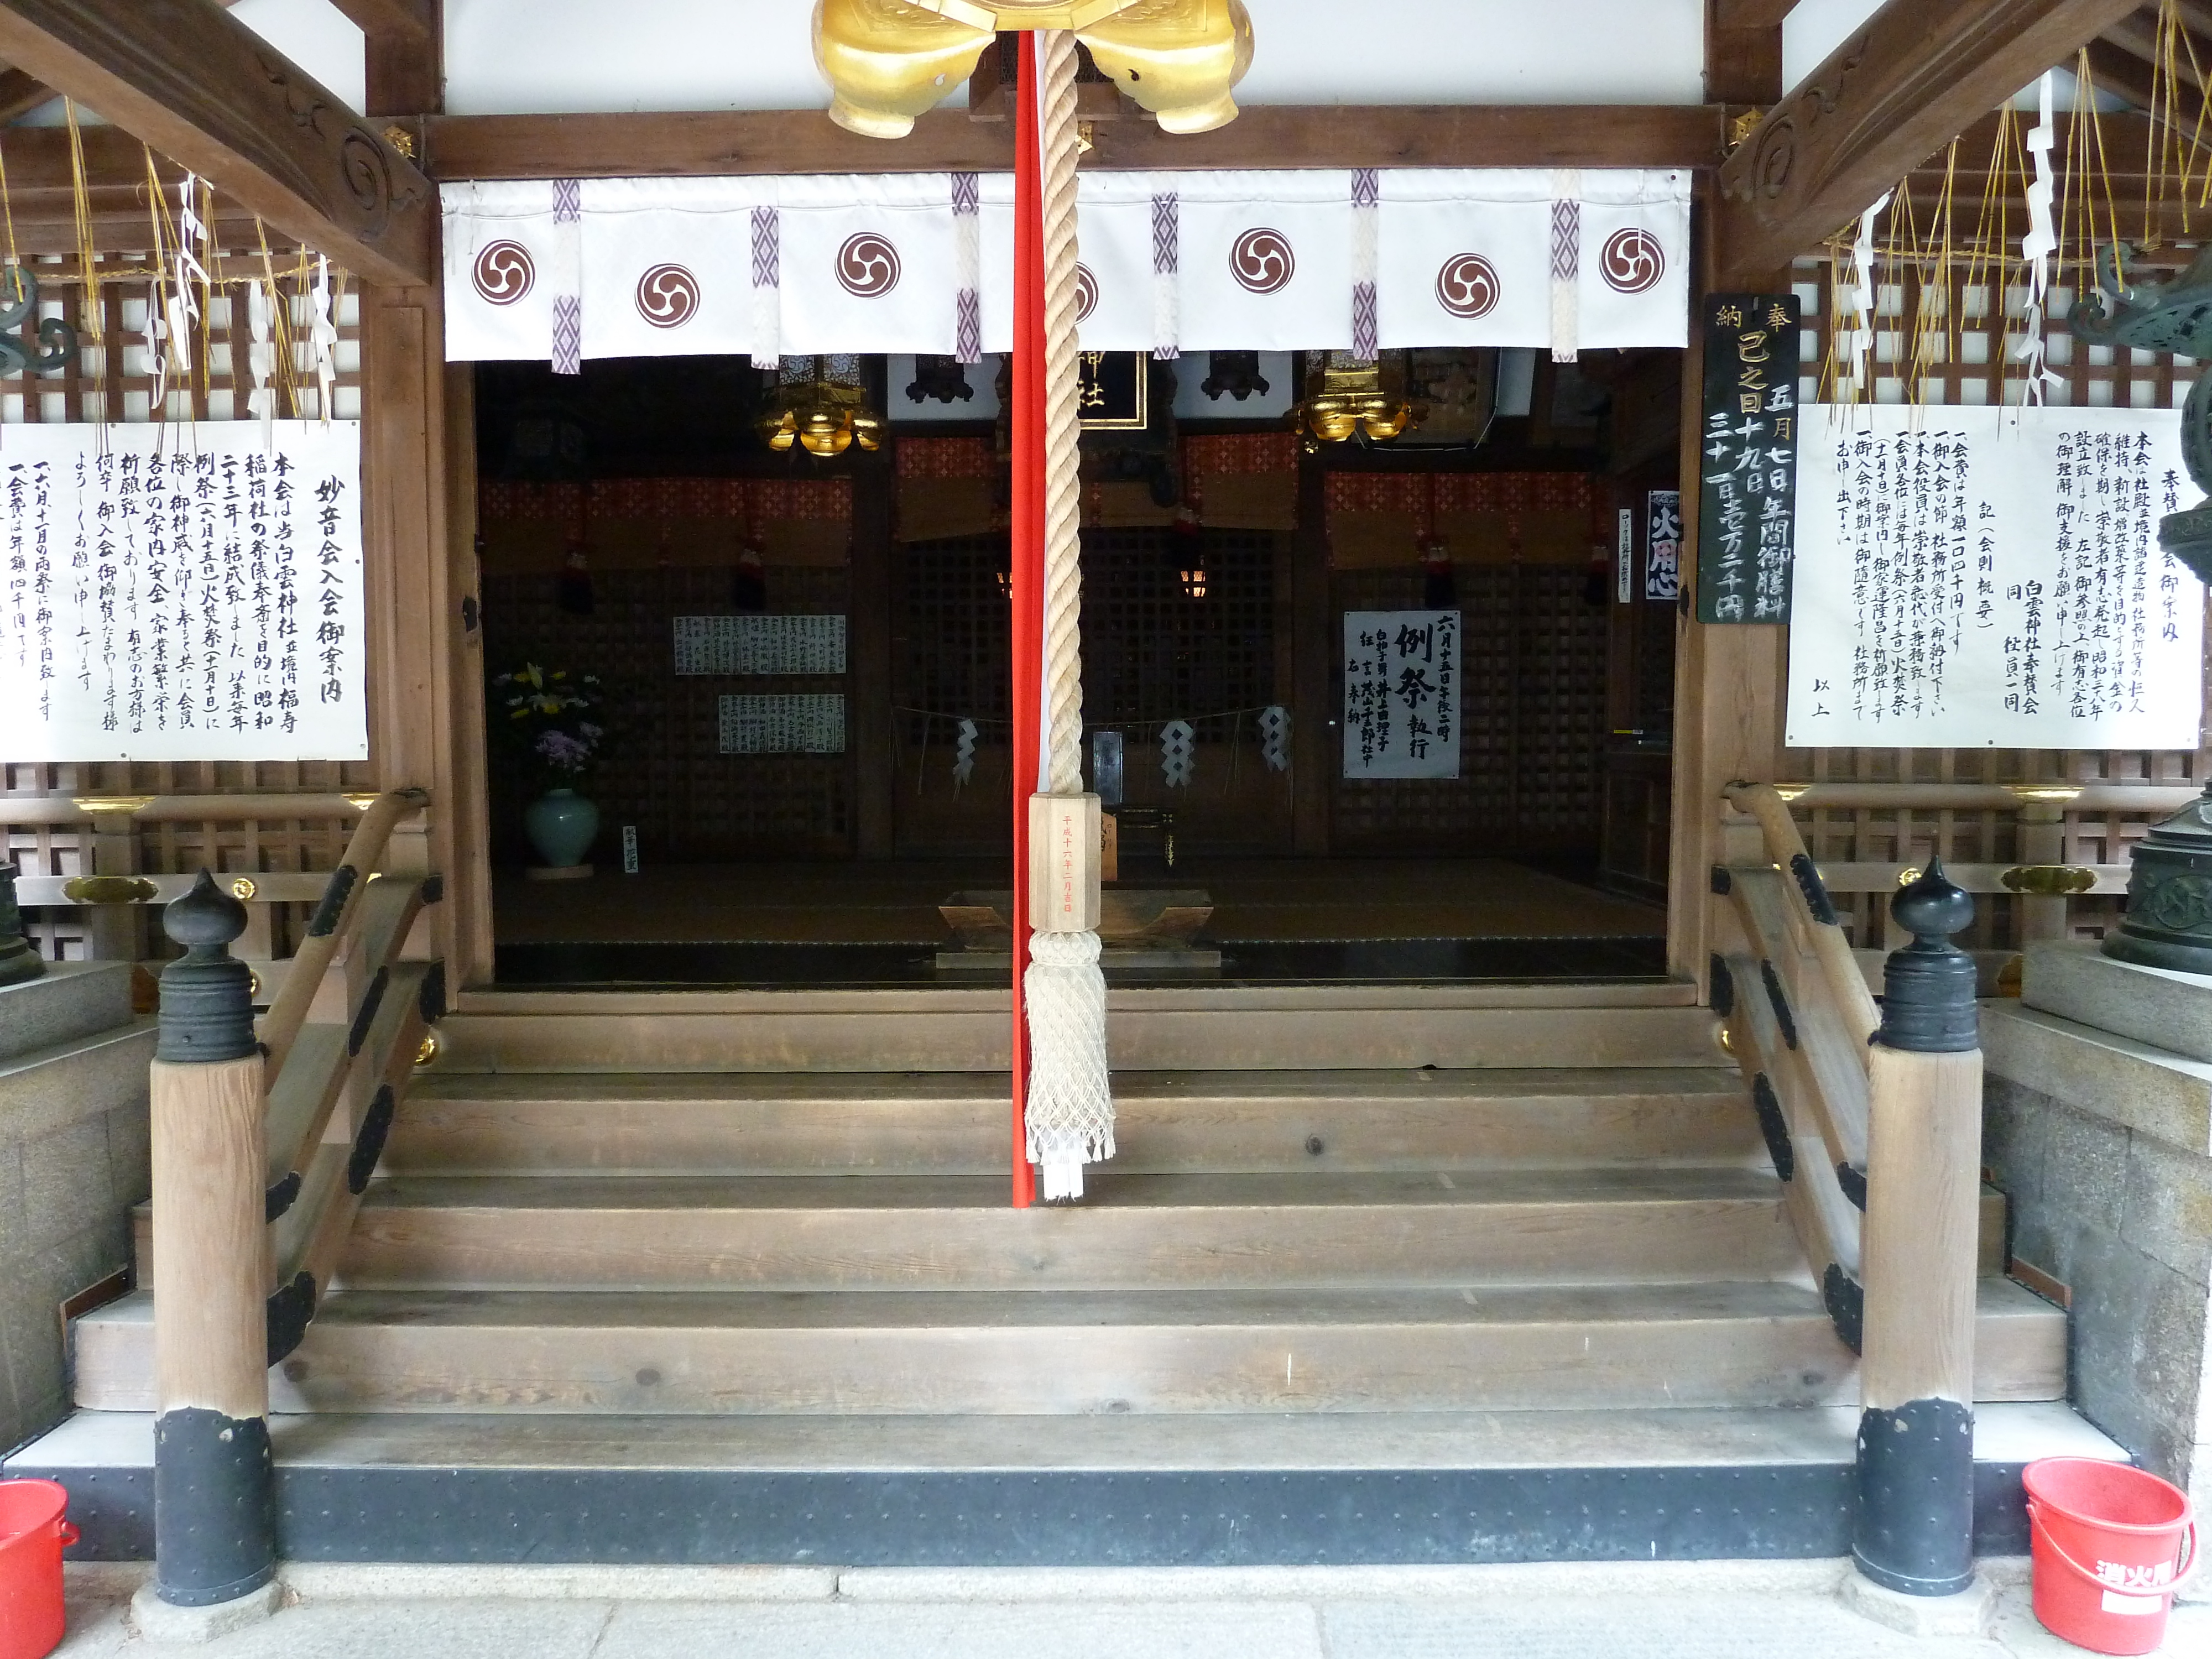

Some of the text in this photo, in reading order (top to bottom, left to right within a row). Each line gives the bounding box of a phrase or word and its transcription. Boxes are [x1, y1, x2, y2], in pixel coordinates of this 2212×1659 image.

[314, 474, 346, 704] 妙音会入会御案内
[1648, 506, 1679, 597] 火用心
[1437, 615, 1456, 743] 六月十五日午後二時
[1811, 678, 1830, 717] 以上
[2002, 583, 2022, 713] 同 役員一同
[2022, 579, 2044, 715] 白雲神社奉賛会
[1062, 815, 1073, 913] 平成十六年二月吉日
